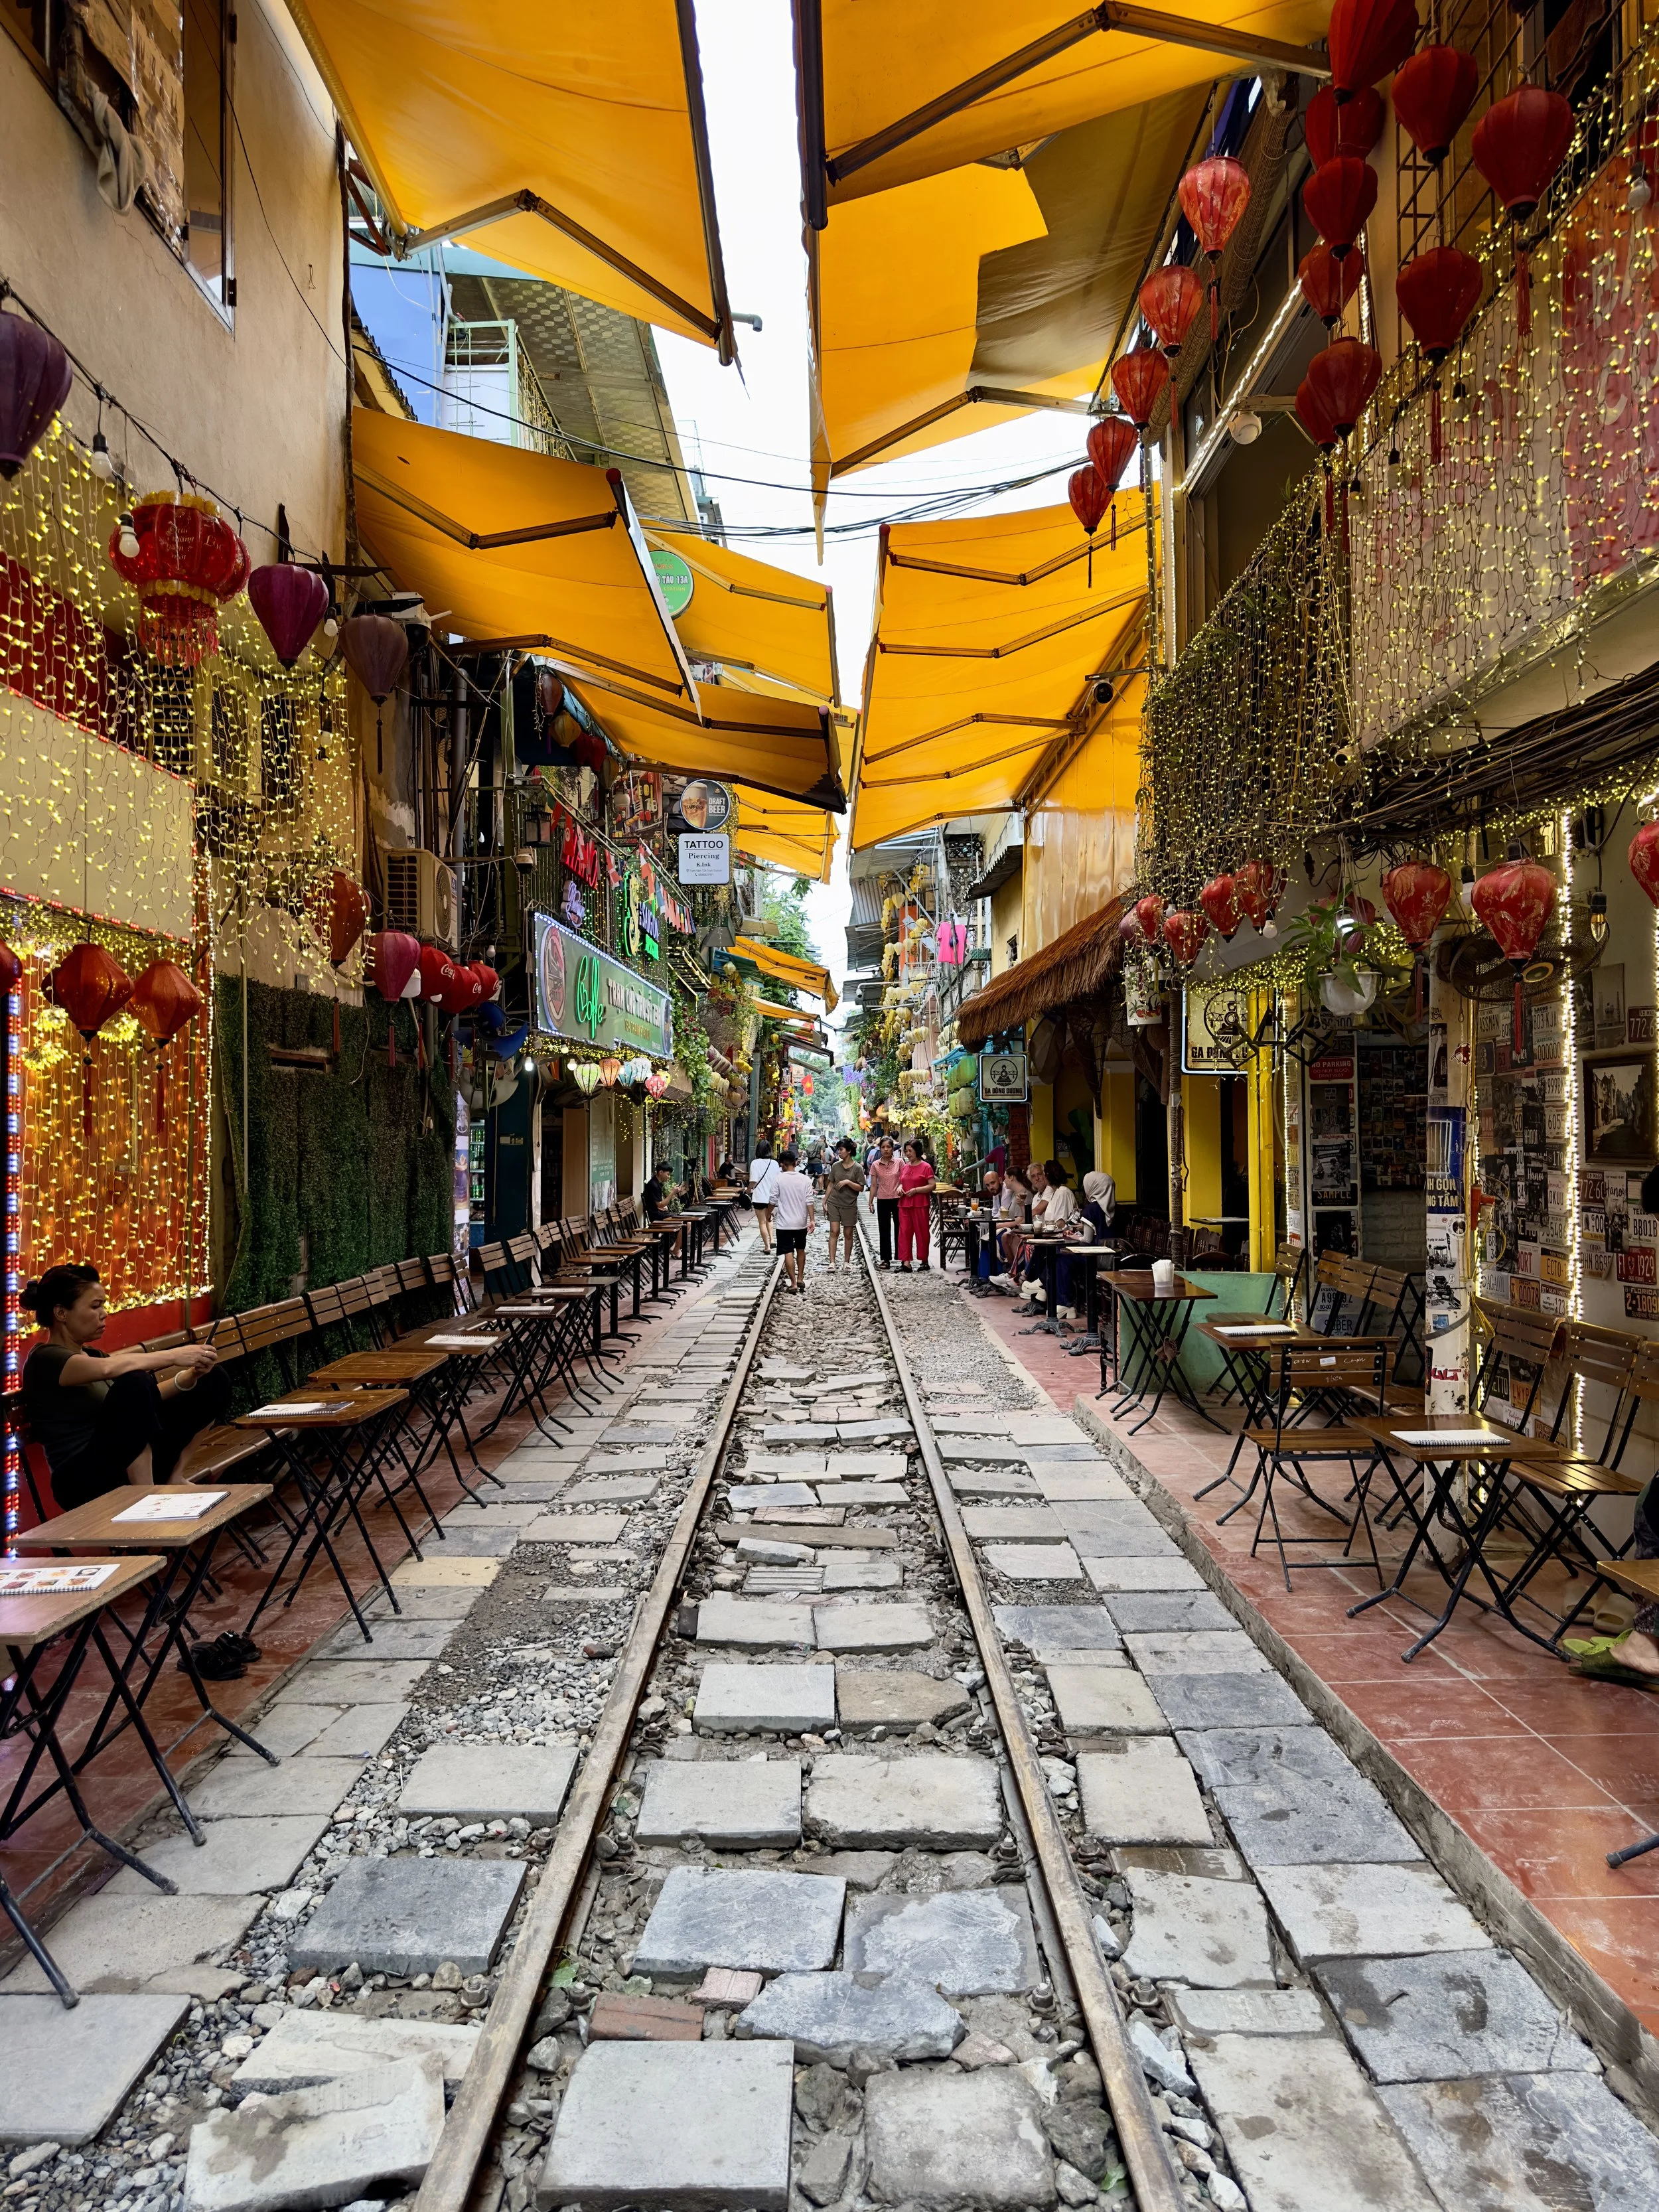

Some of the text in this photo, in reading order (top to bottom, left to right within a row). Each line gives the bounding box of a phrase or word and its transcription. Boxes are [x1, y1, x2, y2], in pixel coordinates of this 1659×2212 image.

[709, 805, 725, 814] BEER
[1480, 1014, 1499, 1032] ASSMAN
[1192, 1047, 1204, 1058] GA
[1436, 1177, 1457, 1193] GỌN
[1605, 1179, 1625, 1197] Hanoi
